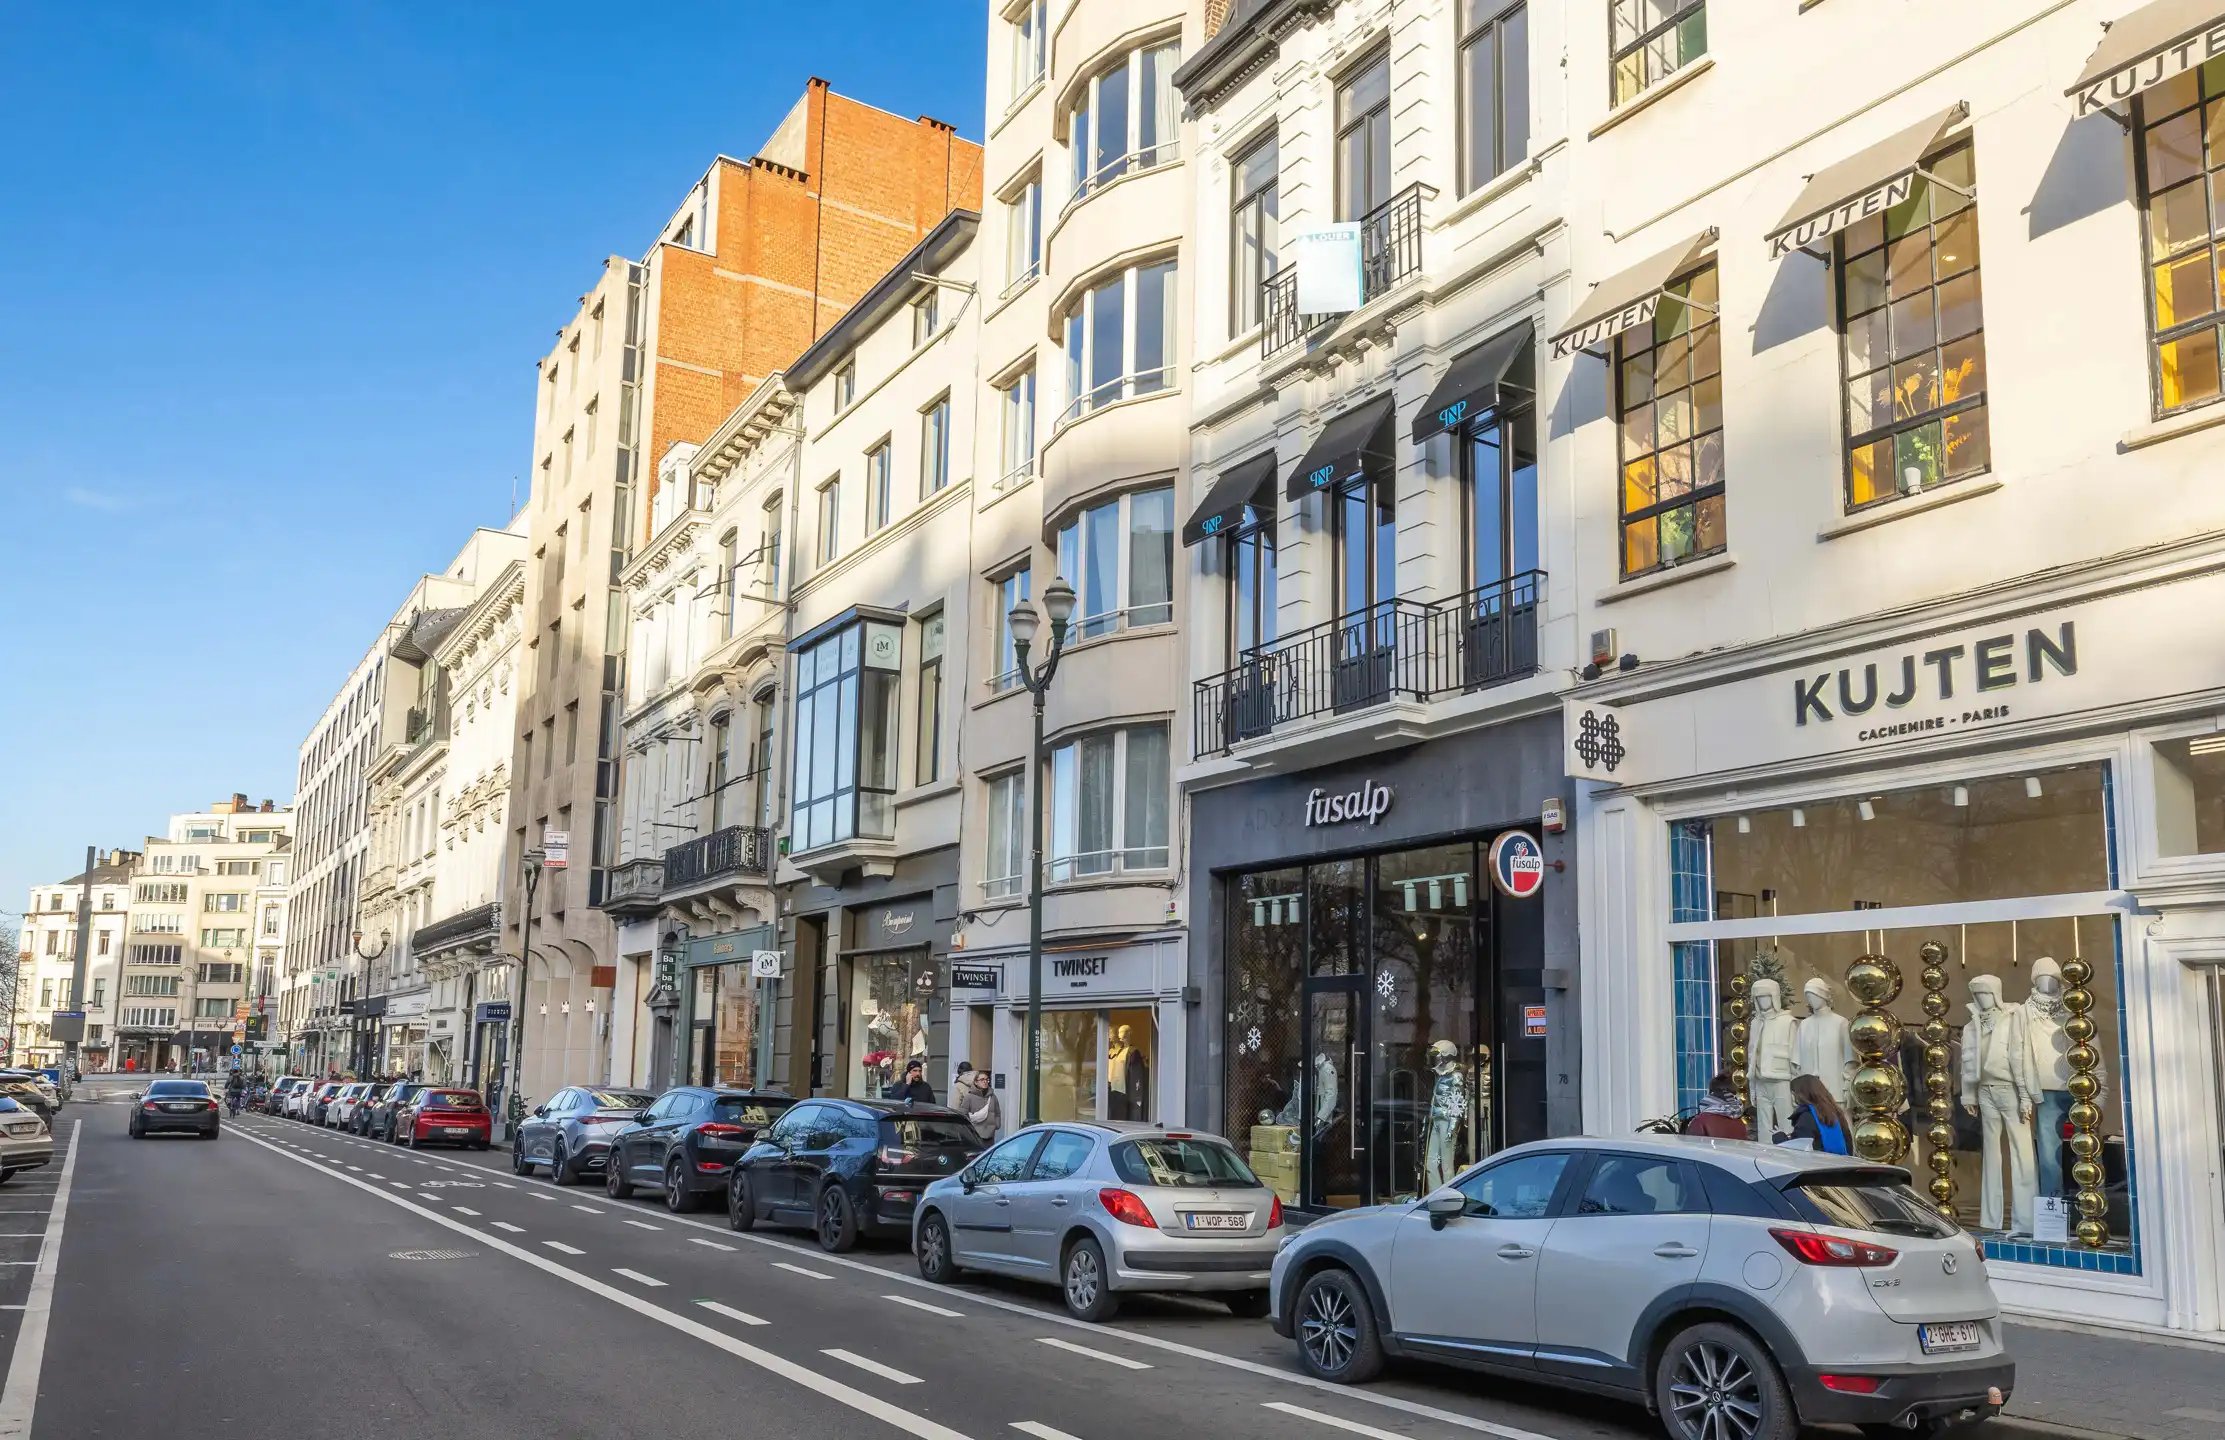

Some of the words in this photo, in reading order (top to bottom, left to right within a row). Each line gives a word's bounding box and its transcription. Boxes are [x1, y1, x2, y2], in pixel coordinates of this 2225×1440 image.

[1772, 176, 1909, 258] KUJTEN
[1553, 296, 1657, 359] KUJTEN
[1795, 621, 2078, 727] KUJTEN
[1858, 716, 1945, 742] CACHEMIRE
[1962, 705, 2010, 724] PARIS
[1305, 779, 1391, 827] fusalp
[1512, 857, 1541, 871] fusalp
[663, 955, 674, 963] Ba
[1053, 957, 1109, 977] TWINSET
[662, 973, 673, 981] ba
[956, 972, 995, 982] TWINSET
[661, 983, 673, 991] ris
[1559, 1074, 1569, 1085] 78
